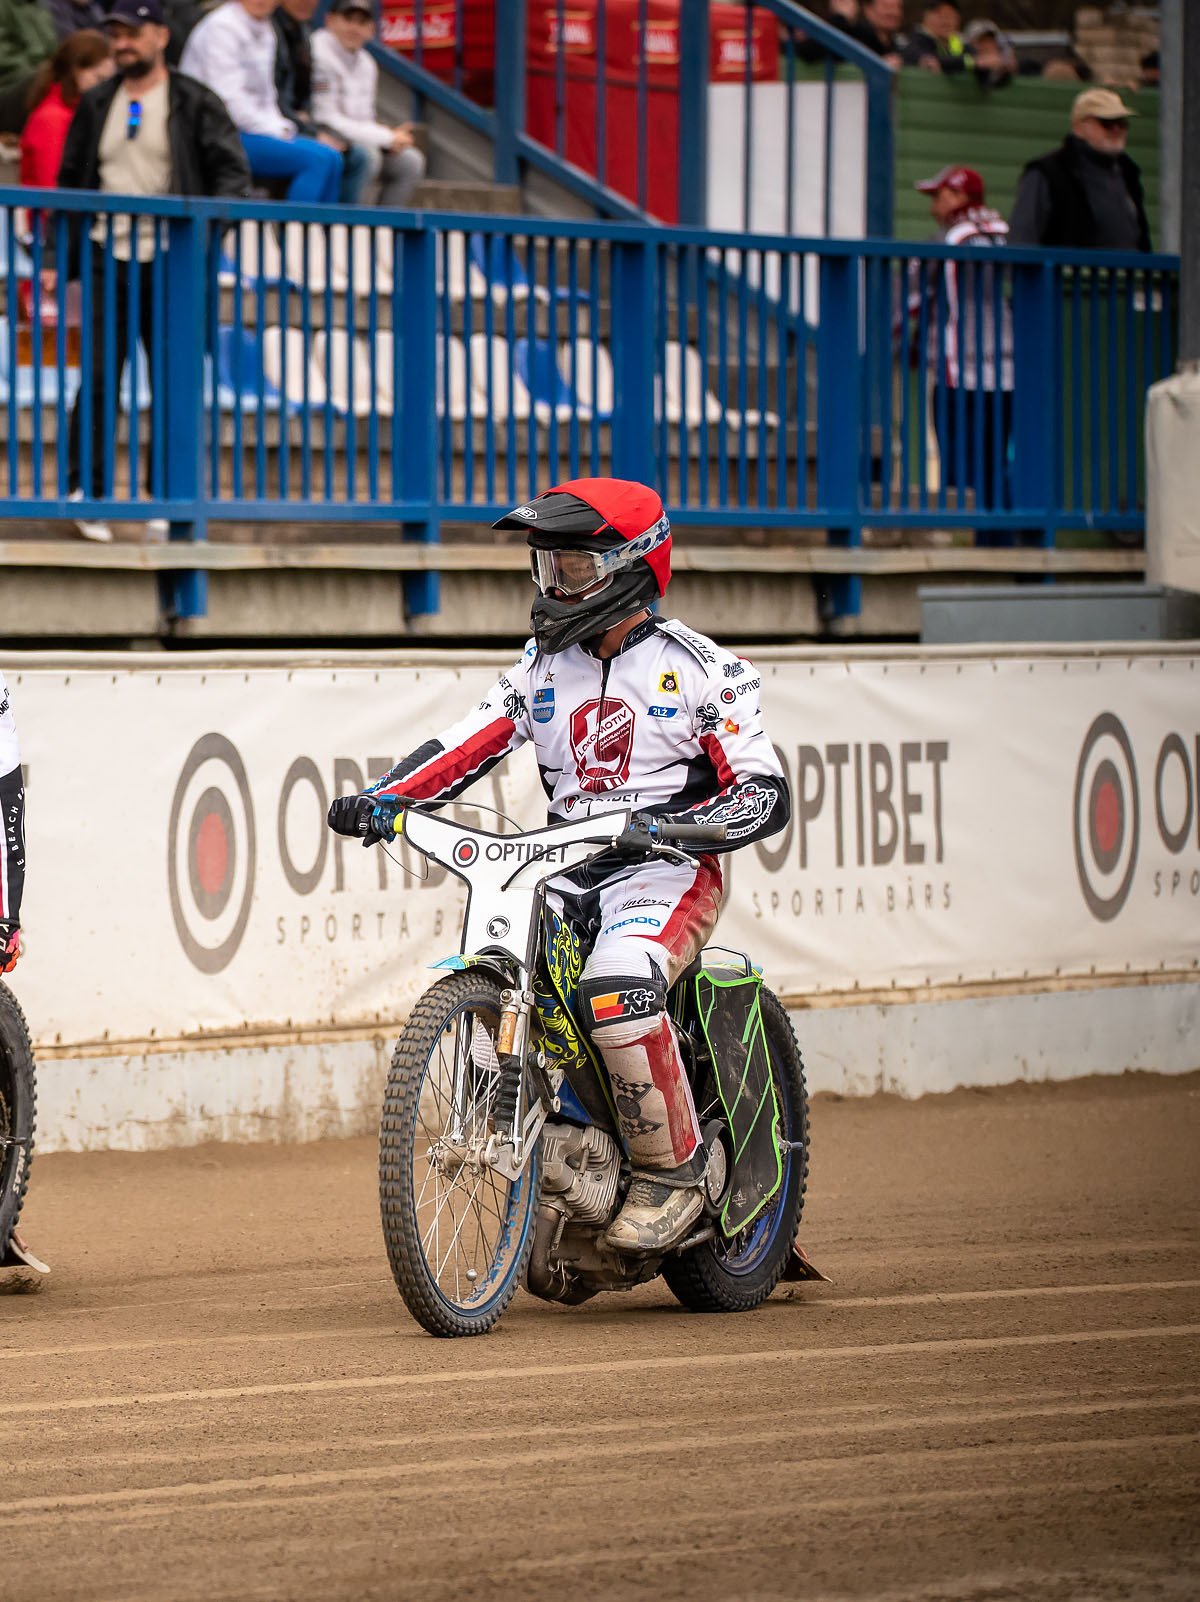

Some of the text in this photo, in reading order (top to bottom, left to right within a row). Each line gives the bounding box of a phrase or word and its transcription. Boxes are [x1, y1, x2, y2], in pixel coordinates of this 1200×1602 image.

[652, 707, 669, 717] 2LŽ
[577, 709, 627, 757] LOKOMOTIV
[8, 806, 19, 851] BEACH
[485, 843, 569, 863] OPTIBET
[752, 886, 865, 919] SPORTA
[276, 911, 411, 945] SPORTA
[602, 916, 661, 936] TRODO
